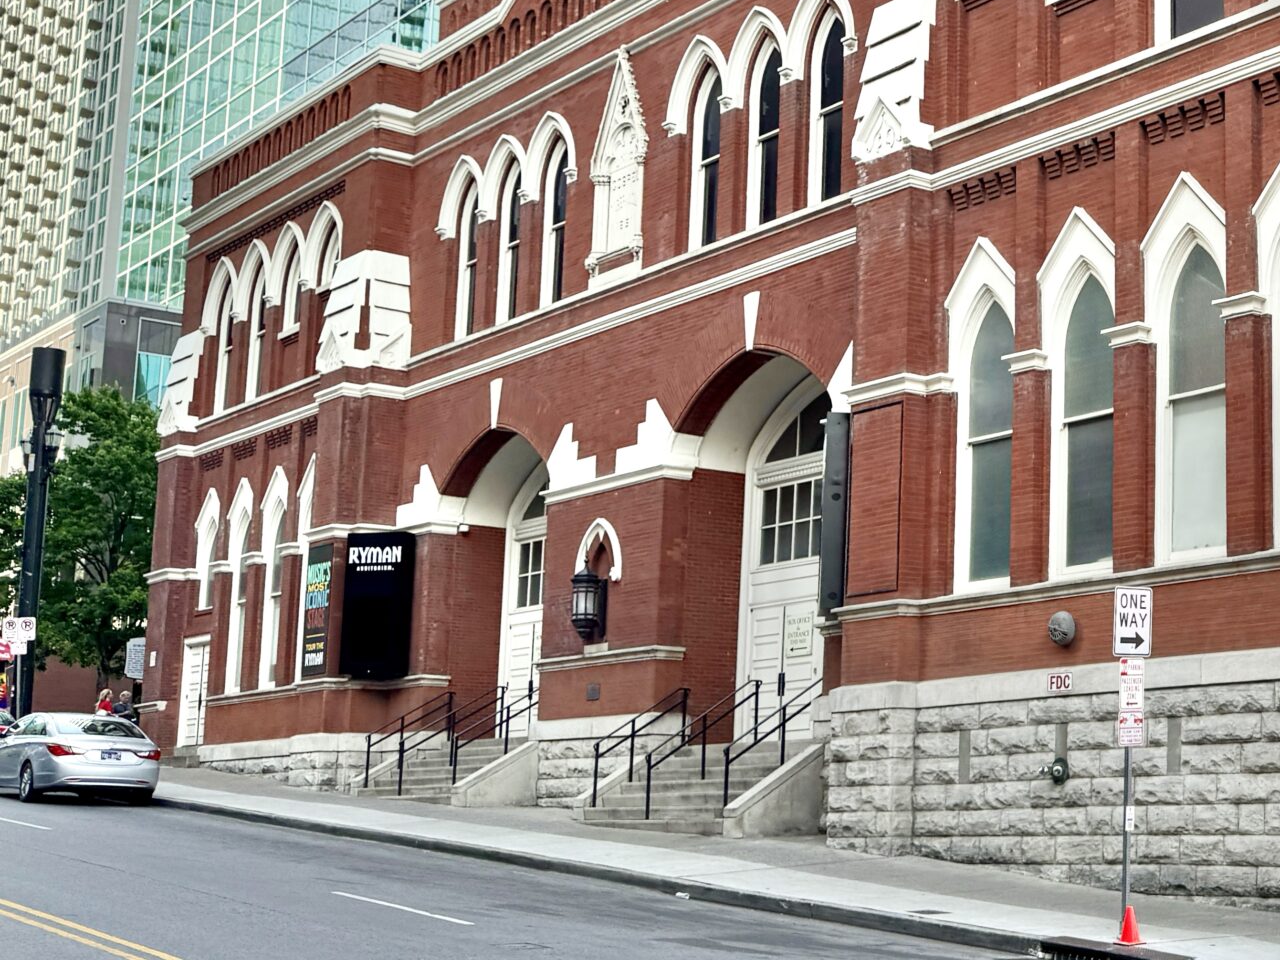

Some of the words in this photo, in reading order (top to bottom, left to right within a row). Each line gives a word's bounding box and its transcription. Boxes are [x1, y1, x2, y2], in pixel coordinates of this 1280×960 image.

[349, 546, 402, 564] RYMAN
[307, 561, 331, 584] MUSIC'S
[308, 582, 328, 592] MOST
[305, 590, 330, 609] ICONIC
[1120, 593, 1147, 609] ONE
[307, 608, 325, 629] STAGE
[1119, 612, 1147, 628] WAY
[304, 652, 324, 666] RYMAN
[1050, 674, 1070, 689] FDC
